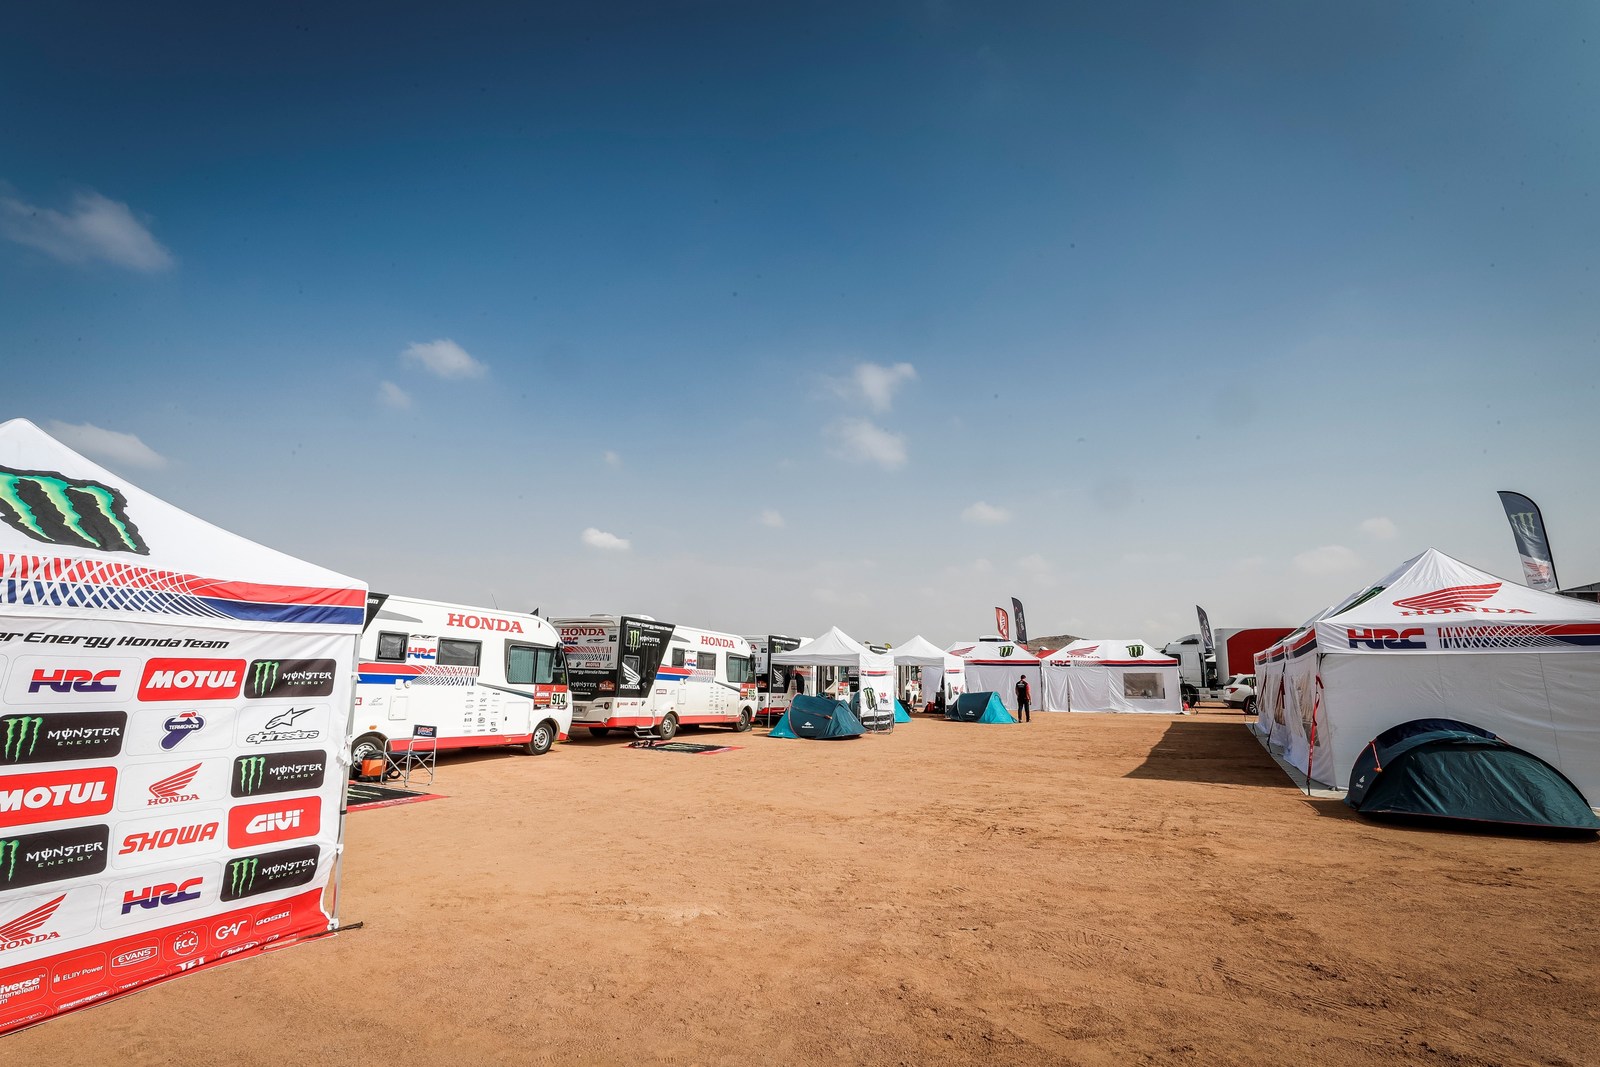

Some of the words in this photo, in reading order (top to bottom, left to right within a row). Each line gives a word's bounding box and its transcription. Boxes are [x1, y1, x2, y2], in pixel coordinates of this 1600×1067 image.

[1399, 607, 1537, 617] HONDA
[446, 613, 524, 634] HONDA
[24, 632, 116, 648] Energy
[117, 636, 182, 648] Honda
[183, 638, 229, 649] Team
[701, 635, 735, 648] HONDA
[1347, 628, 1427, 649] HRC
[407, 646, 436, 660] HRC
[28, 669, 121, 693] HRC
[145, 670, 237, 688] MOTUL
[282, 671, 332, 680] MONSTER
[552, 693, 566, 705] 914
[47, 727, 120, 740] MONSTER
[246, 730, 319, 744] alpinestars
[57, 738, 109, 746] ENERGY
[269, 763, 323, 775] MONSTER
[0, 781, 108, 812] MOTUL
[147, 794, 200, 806] HONDA
[246, 809, 300, 834] GIVI
[118, 822, 219, 855] SHOWA
[26, 842, 104, 862] MONSTER
[37, 855, 92, 868] ENERGY
[261, 858, 315, 875] MONSTER
[268, 868, 307, 880] ENERGY
[121, 877, 203, 915] HRC
[256, 911, 290, 926] GOSHI
[118, 948, 151, 963] EVANS
[82, 965, 103, 976] Power
